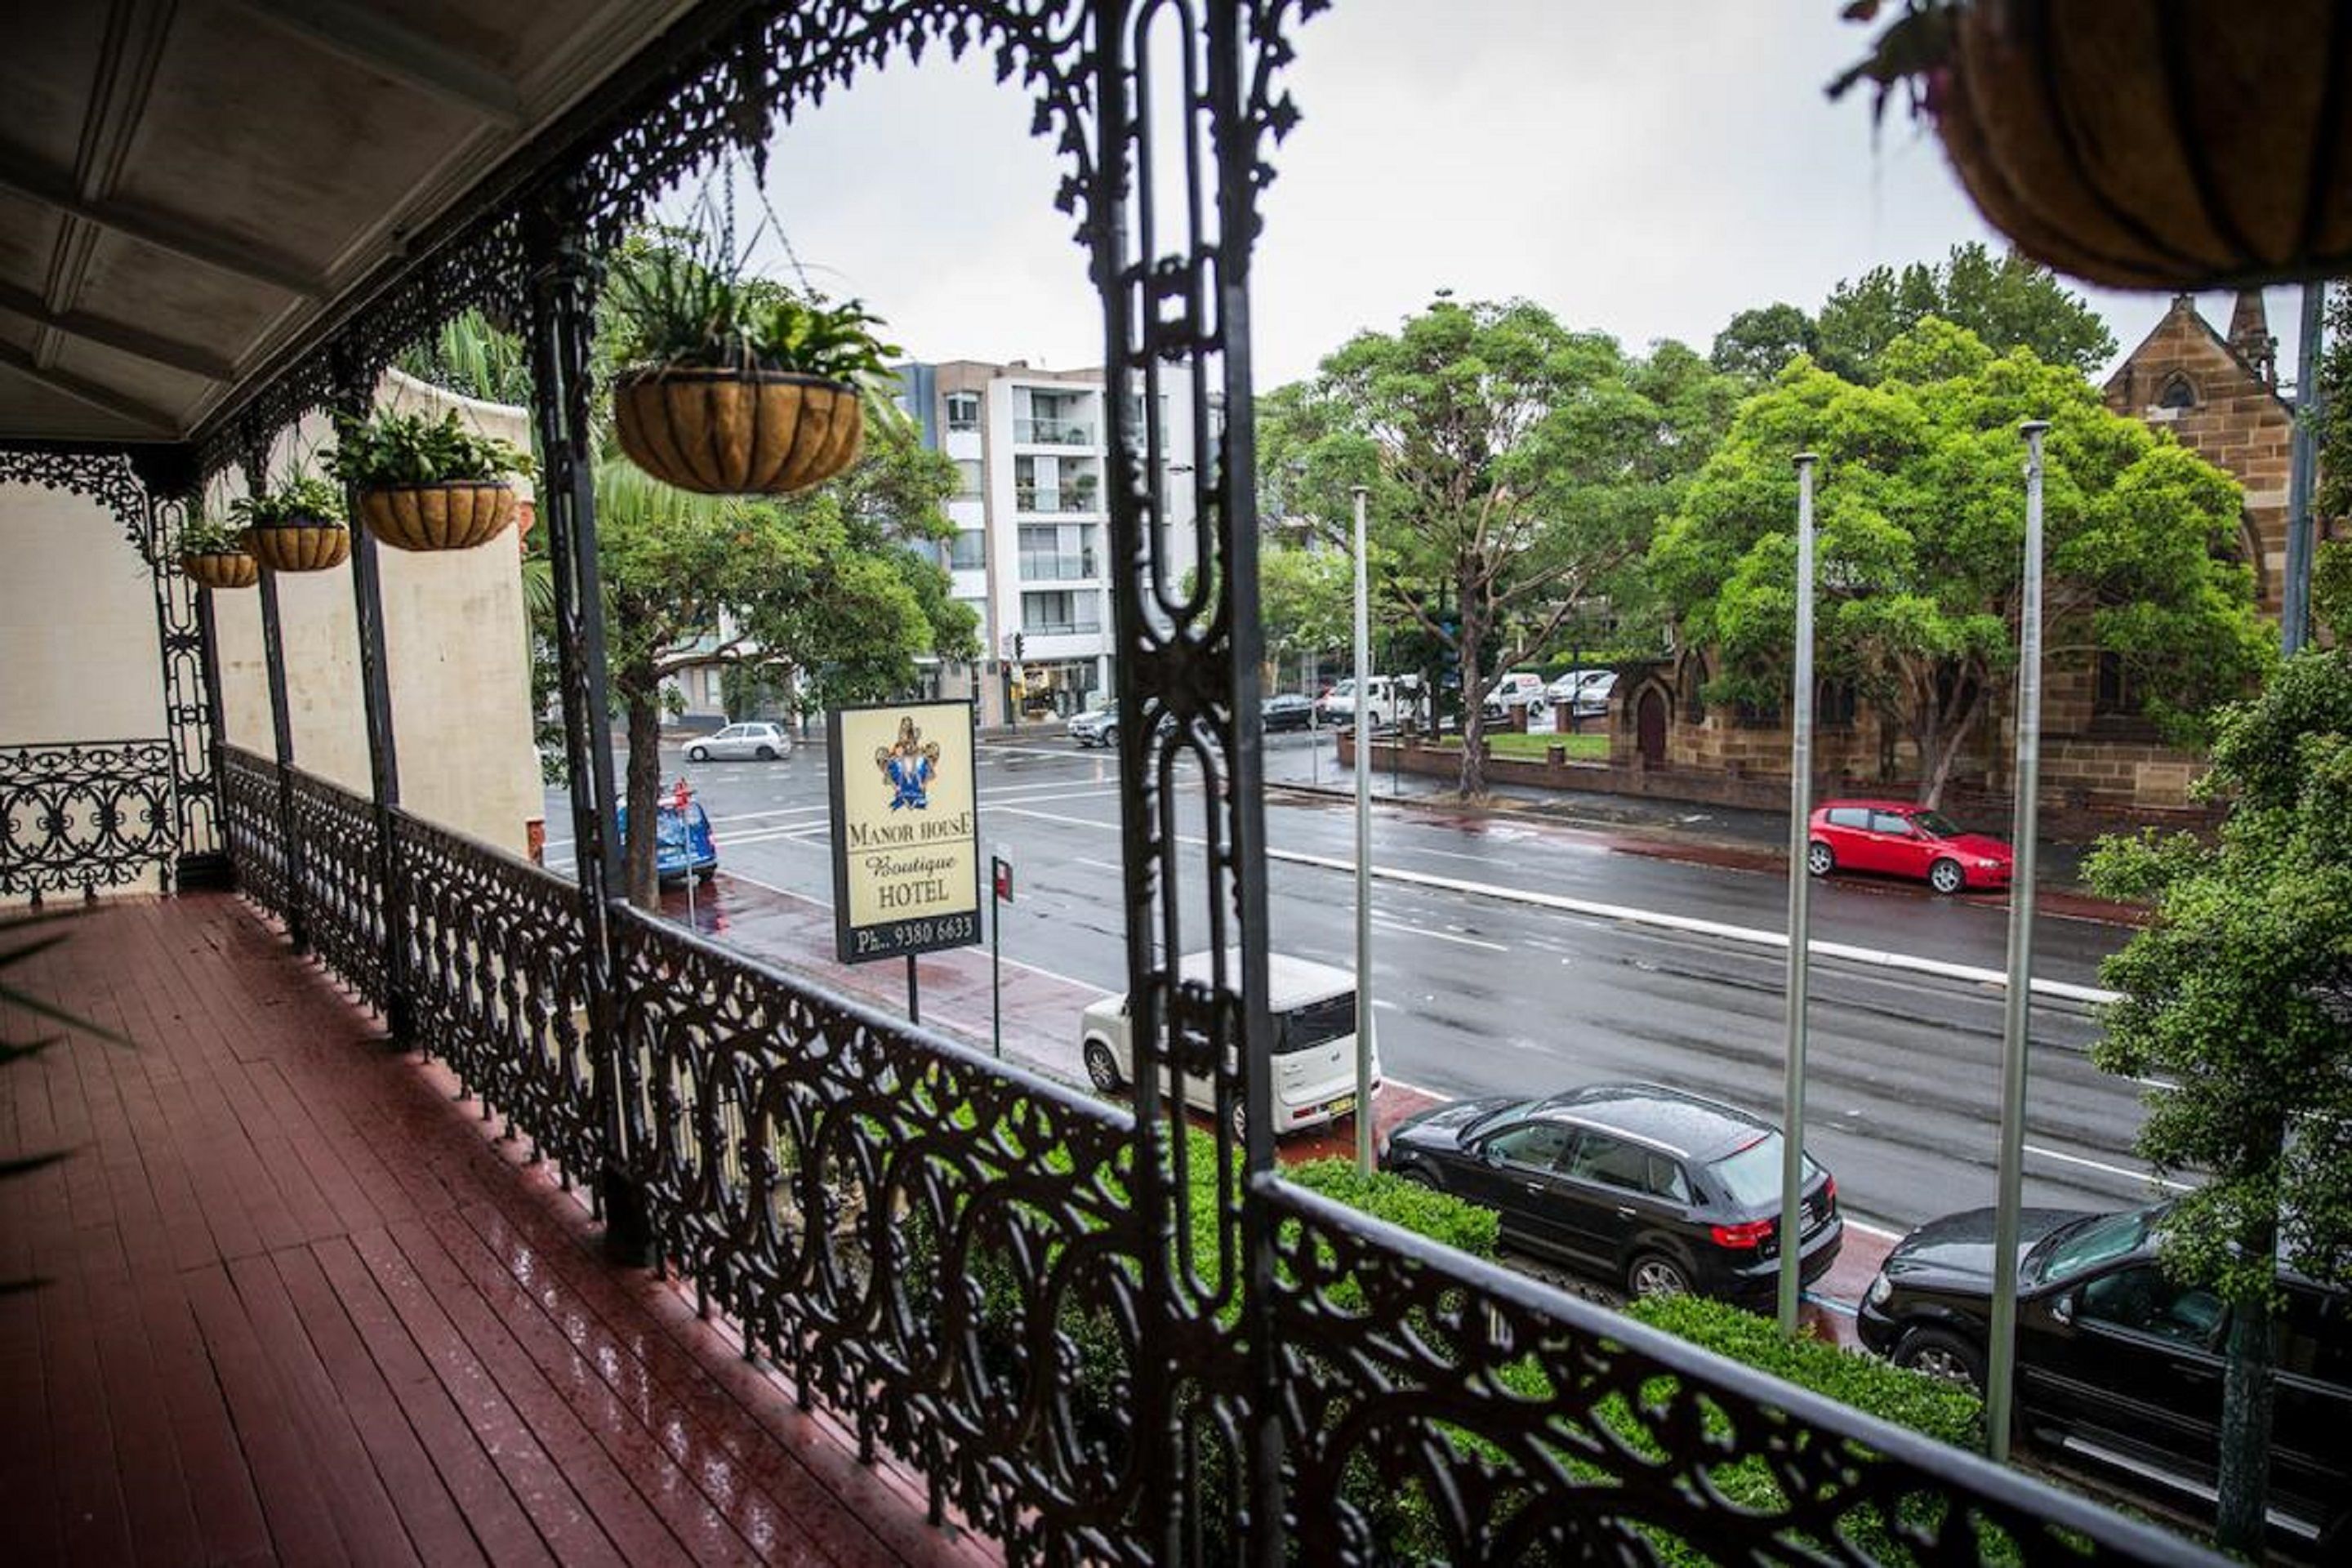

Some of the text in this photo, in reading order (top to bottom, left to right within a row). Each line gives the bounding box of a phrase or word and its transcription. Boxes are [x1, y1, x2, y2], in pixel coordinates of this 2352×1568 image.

[849, 812, 973, 848] MANOR HOUSE
[866, 855, 956, 878] Boutique
[879, 879, 950, 908] HOTEL
[894, 921, 933, 947] 9380
[937, 916, 973, 940] 6633
